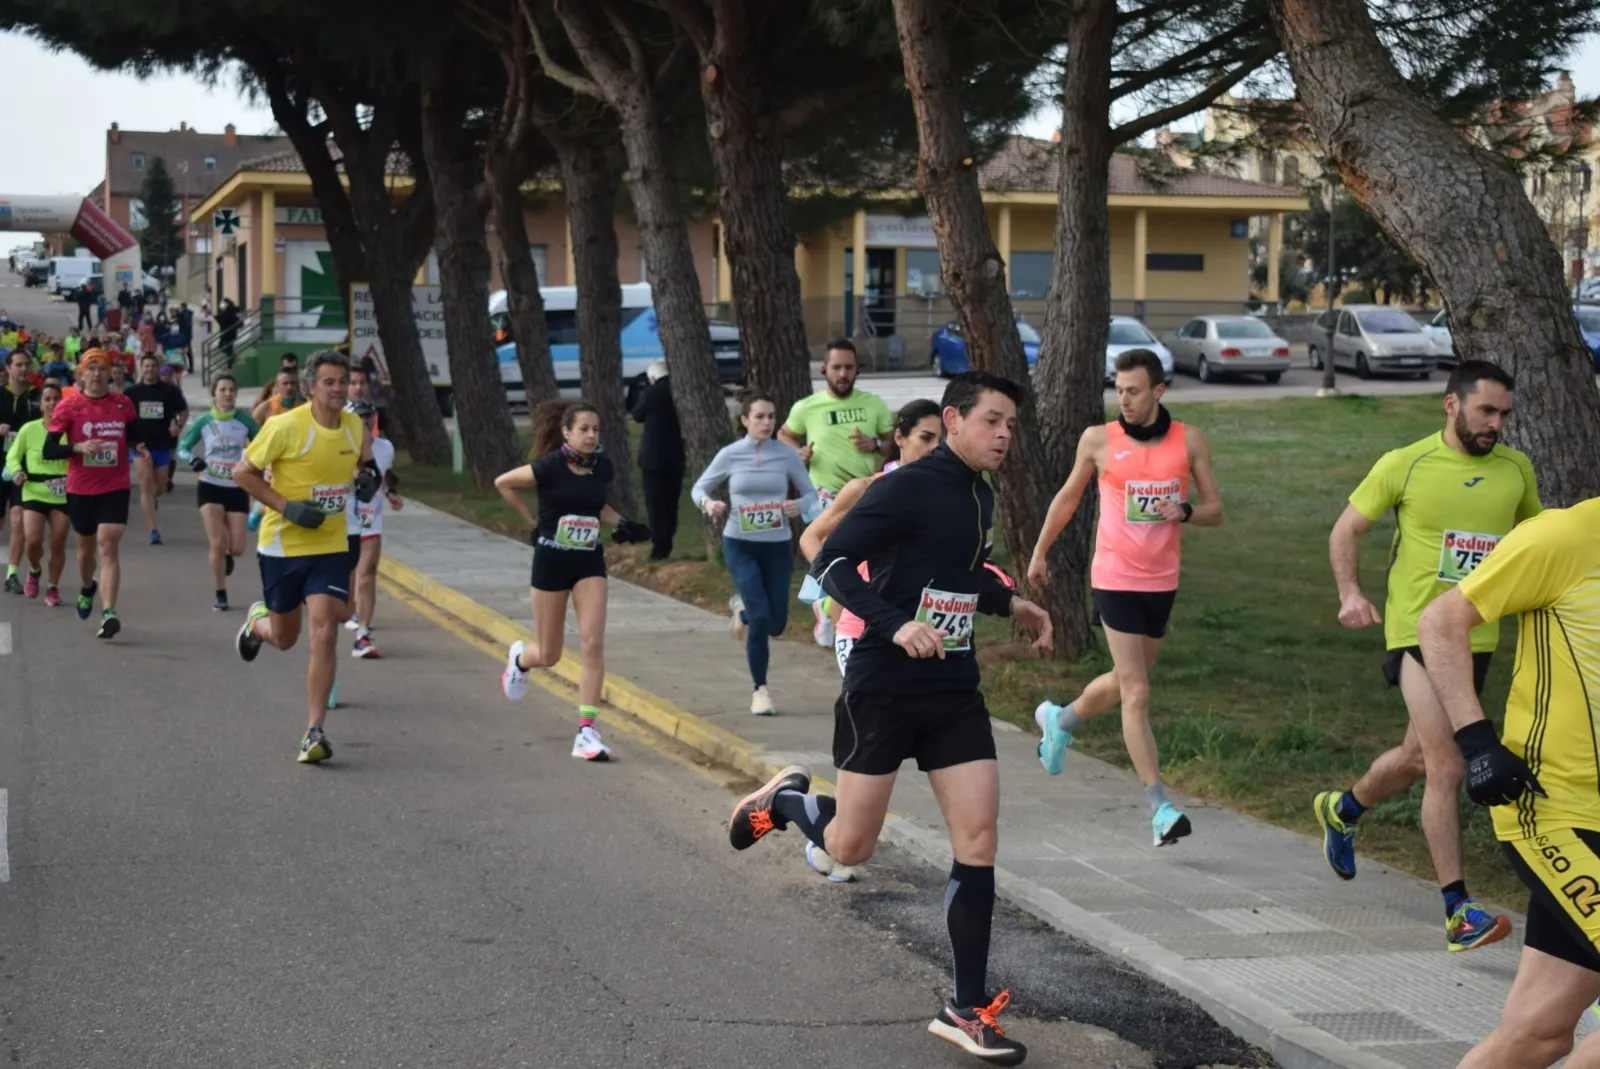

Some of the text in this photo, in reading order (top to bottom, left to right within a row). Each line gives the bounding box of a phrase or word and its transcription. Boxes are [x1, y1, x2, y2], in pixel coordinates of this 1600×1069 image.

[319, 496, 344, 509] 753
[747, 511, 774, 525] 732
[567, 527, 591, 540] 717
[1456, 549, 1489, 570] 75
[931, 612, 968, 636] 749
